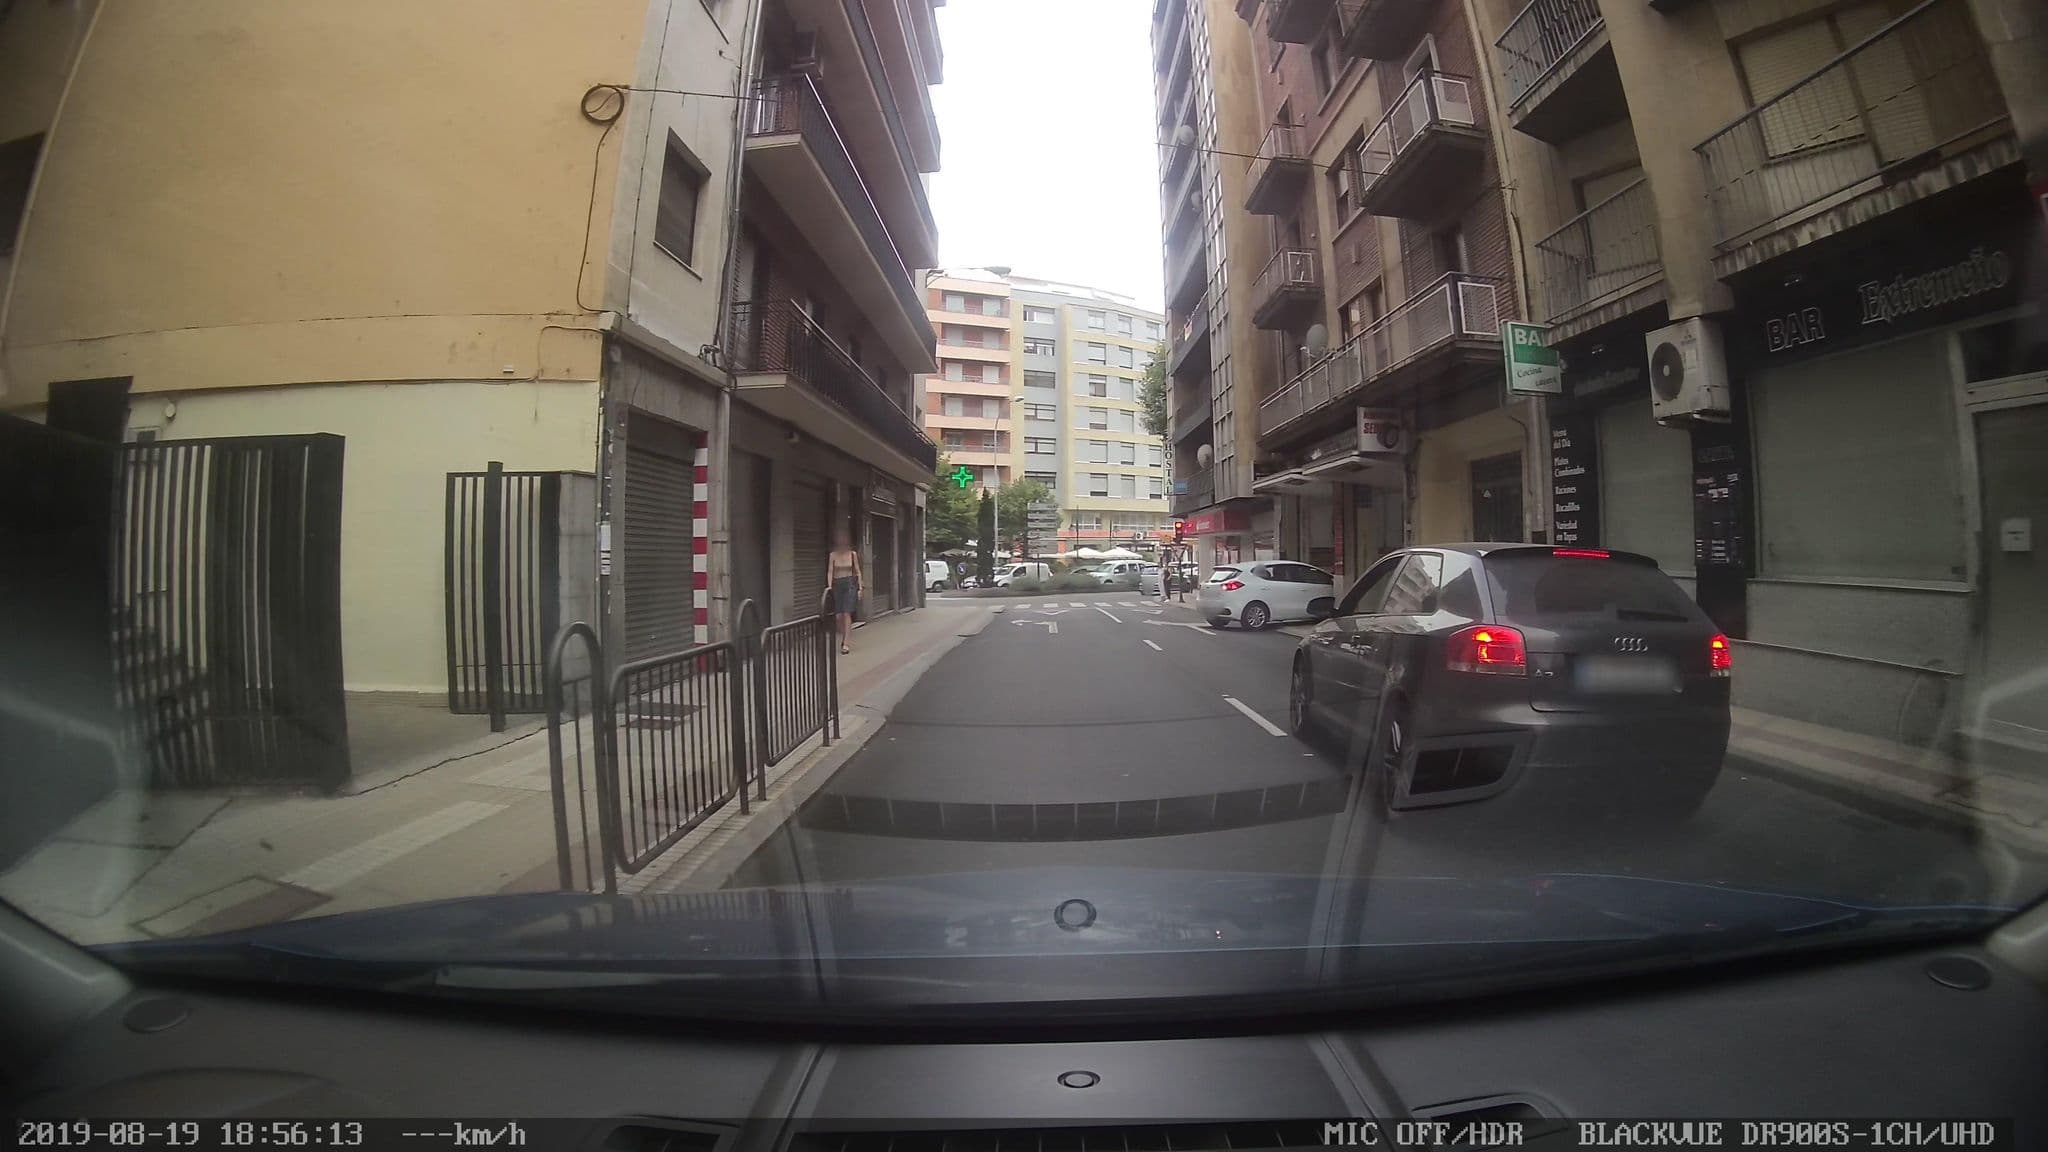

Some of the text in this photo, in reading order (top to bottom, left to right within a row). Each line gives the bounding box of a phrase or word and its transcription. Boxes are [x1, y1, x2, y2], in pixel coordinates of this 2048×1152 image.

[1766, 247, 2010, 352] BAR Extremeño
[1513, 328, 1547, 346] BA
